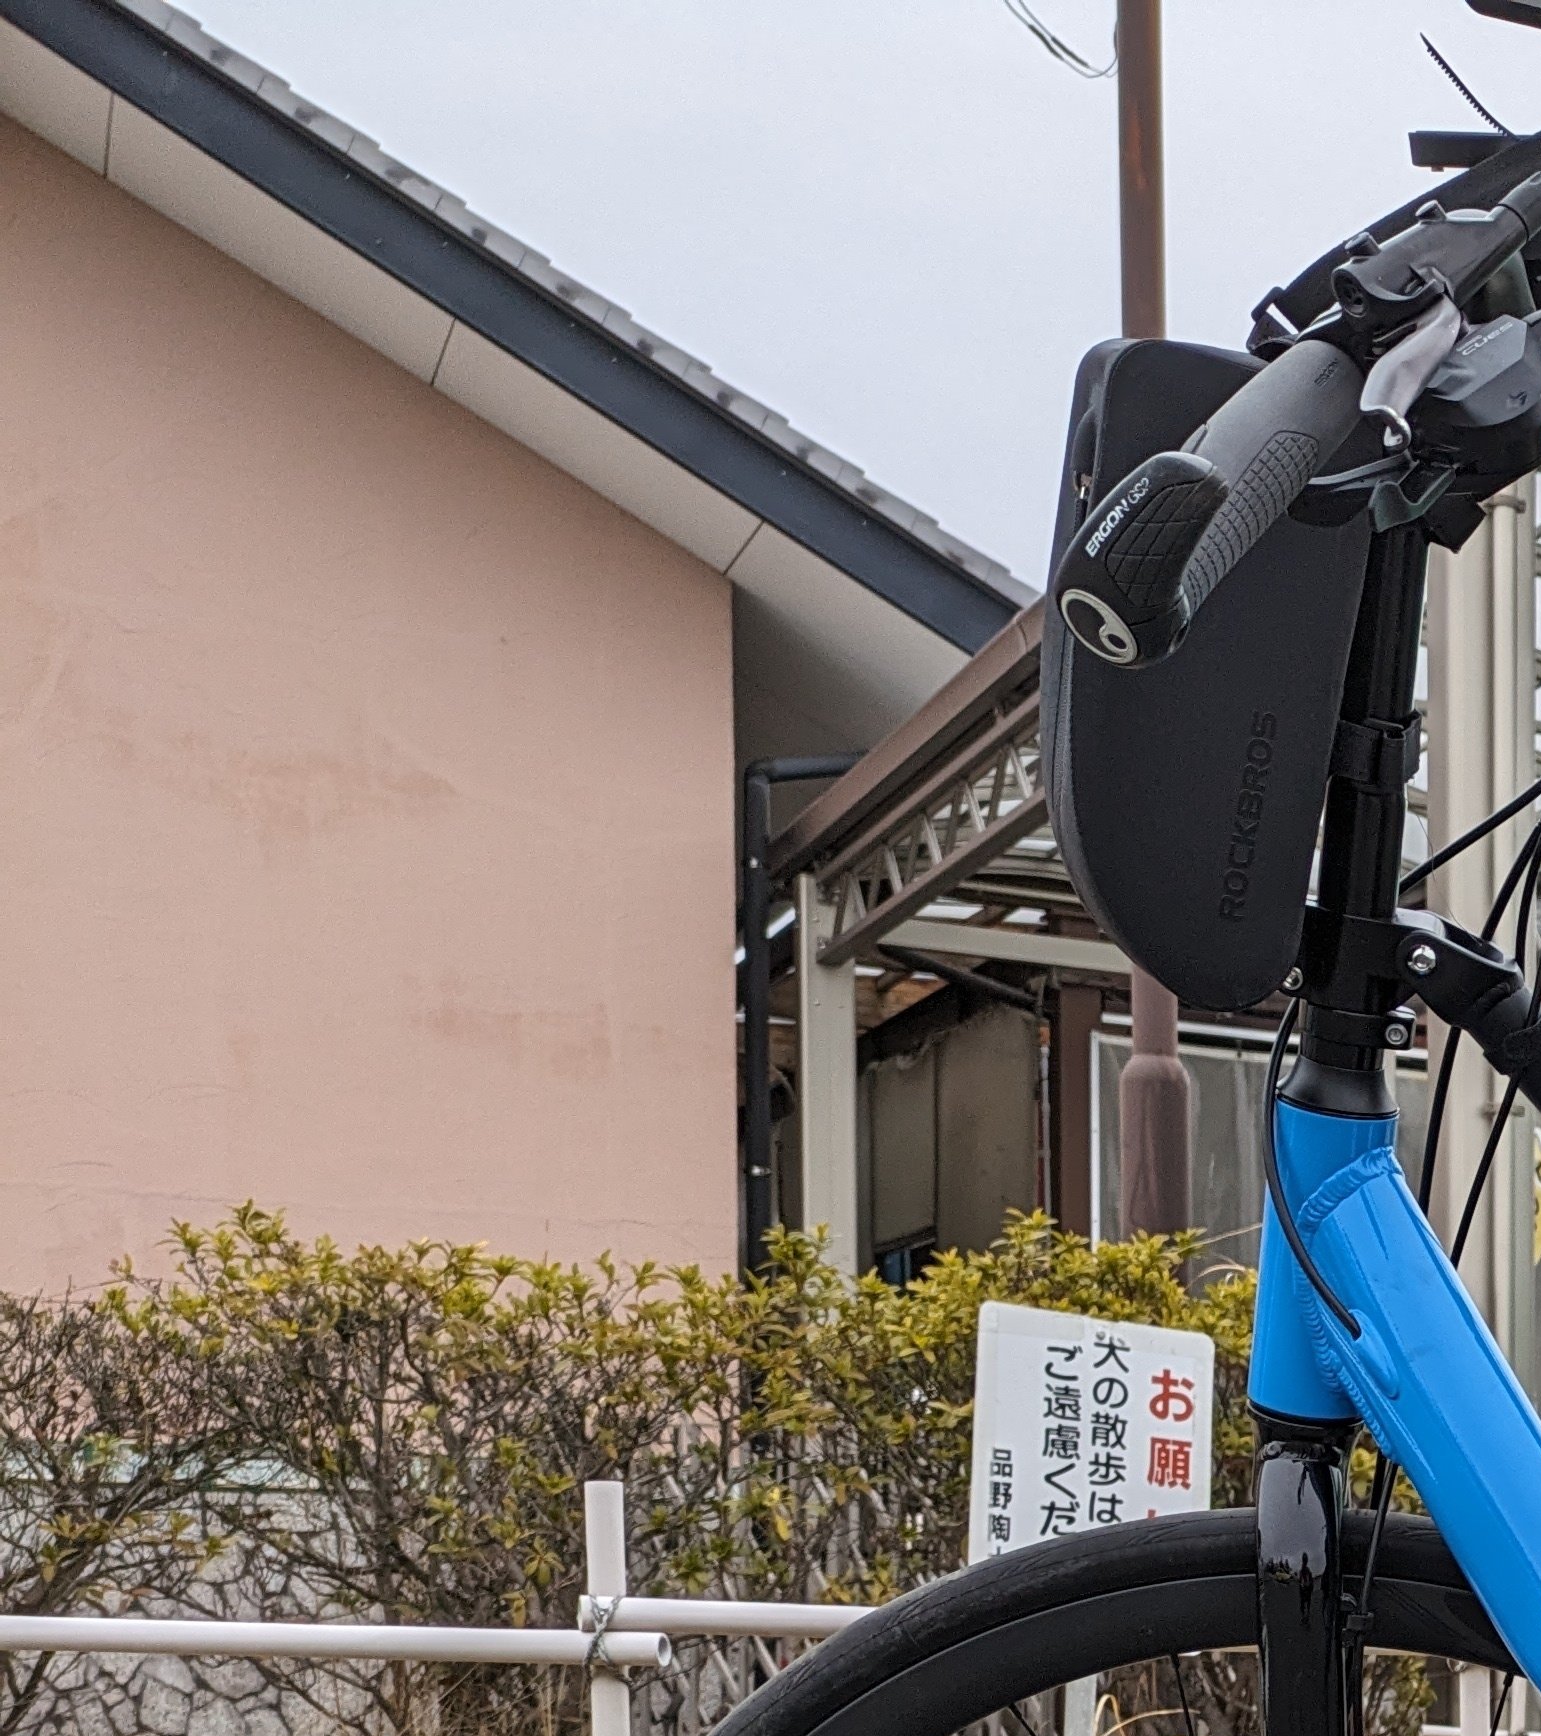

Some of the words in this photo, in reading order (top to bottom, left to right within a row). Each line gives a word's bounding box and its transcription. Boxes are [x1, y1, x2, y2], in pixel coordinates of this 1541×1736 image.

[1085, 499, 1130, 558] ERGON
[1218, 710, 1277, 921] ROCKBROS
[987, 1447, 1014, 1557] 品野陶
[1087, 1332, 1131, 1524] 犬の散歩は
[1147, 1368, 1195, 1520] お願
